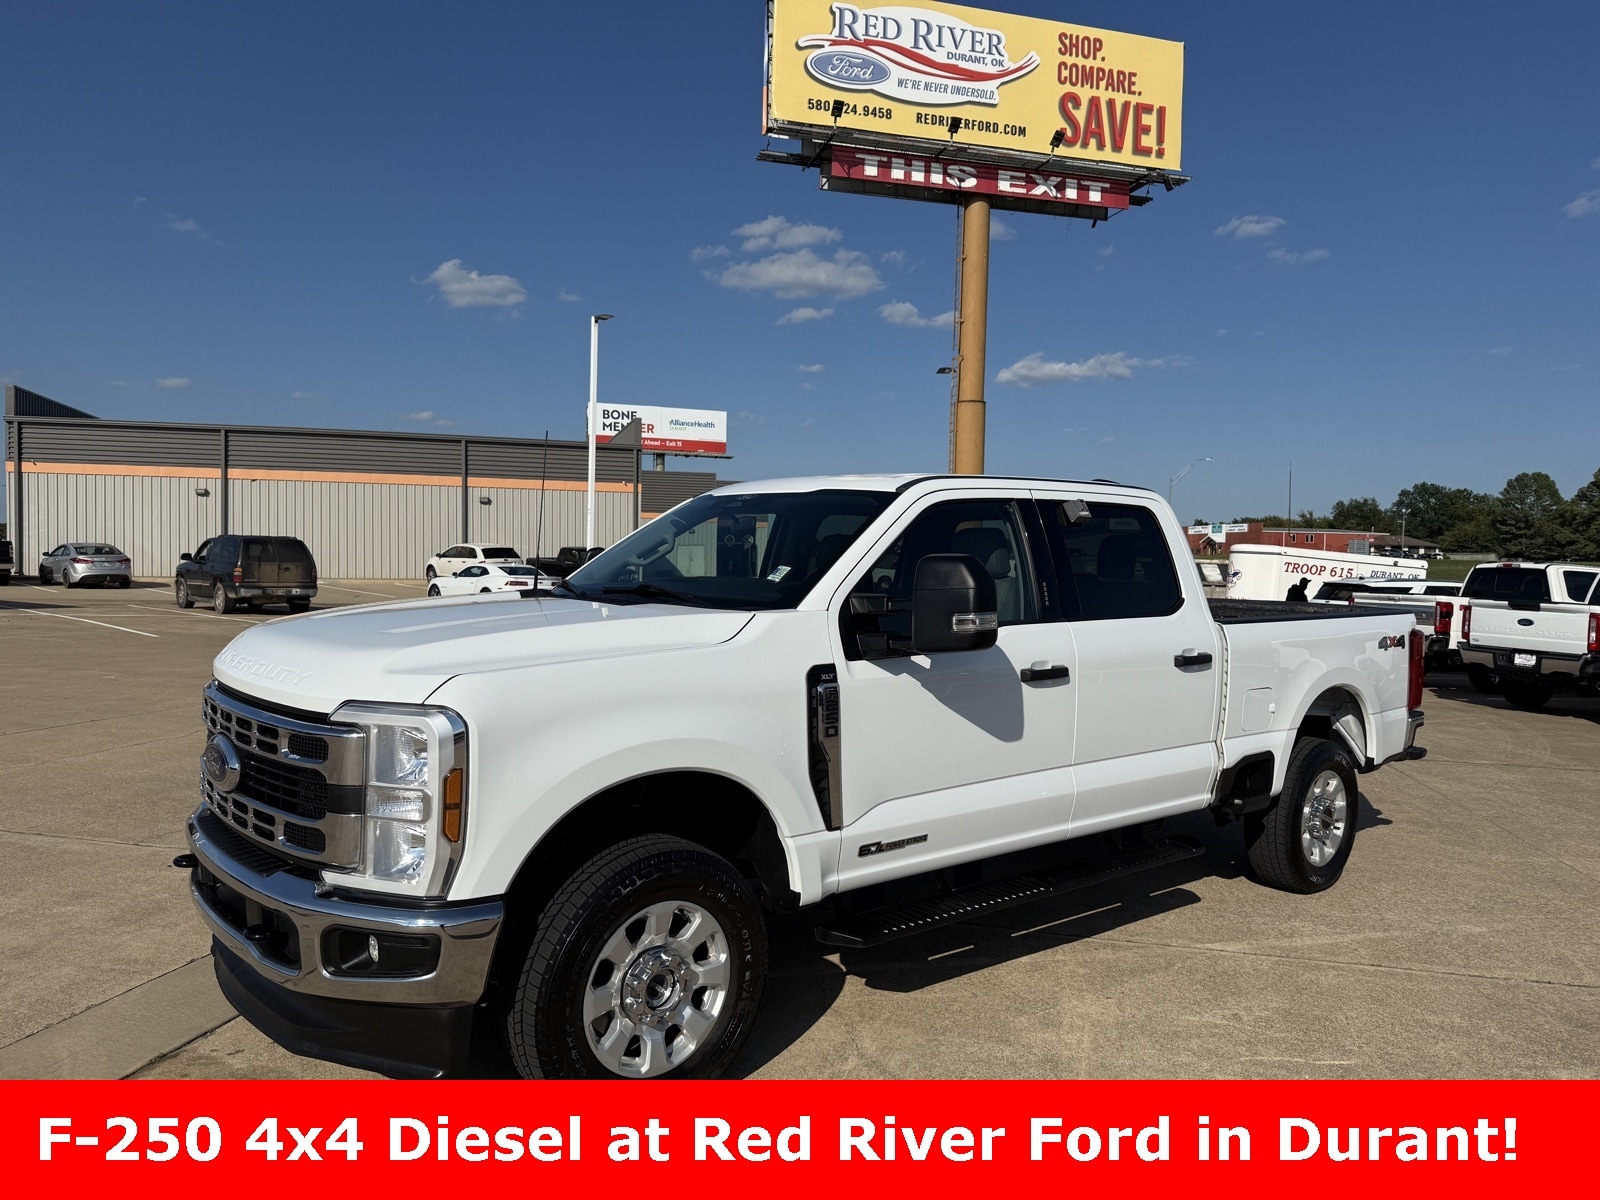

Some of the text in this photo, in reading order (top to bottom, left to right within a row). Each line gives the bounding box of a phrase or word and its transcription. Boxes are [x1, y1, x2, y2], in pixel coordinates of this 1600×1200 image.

[833, 6, 1005, 58] RED RIVER
[946, 51, 1006, 68] DURANT, OK
[1057, 31, 1106, 62] SHOP.
[827, 56, 875, 80] Ford
[1057, 61, 1143, 97] COMPARE.
[897, 77, 997, 102] WE'RE NEVER UNDERSOLD.
[1059, 91, 1167, 158] SAVE!
[855, 152, 1111, 203] THIS EXIT
[669, 419, 716, 429] AllianceHealth
[1284, 562, 1354, 579] TROOP 615
[250, 660, 313, 686] DUTY
